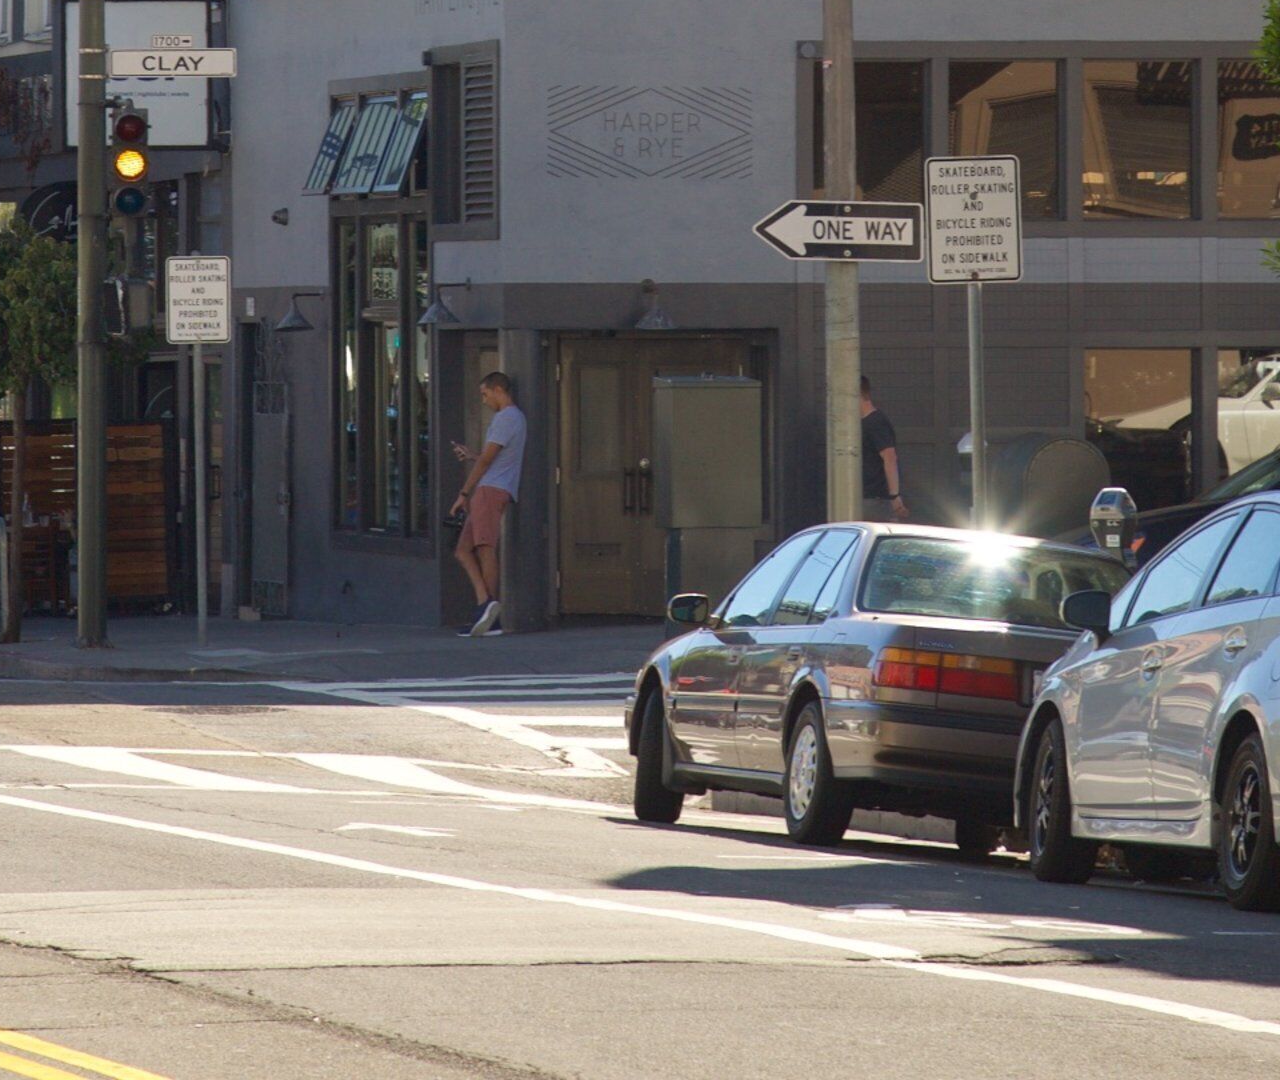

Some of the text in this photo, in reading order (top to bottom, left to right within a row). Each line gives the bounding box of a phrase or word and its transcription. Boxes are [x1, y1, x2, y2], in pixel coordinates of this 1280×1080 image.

[154, 37, 180, 46] 1700
[142, 56, 204, 71] CLAY
[602, 112, 702, 134] HARPER
[639, 137, 684, 159] RYE
[938, 167, 1006, 179] SKATEBOARD,
[931, 182, 1014, 195] ROLLER SKATING
[963, 201, 984, 212] AND
[813, 219, 907, 241] ONE WAY
[936, 217, 1012, 230] BICYCLE RIDING
[945, 235, 1004, 246] PROHIBITED
[942, 252, 1008, 264] ON SIDEWALK
